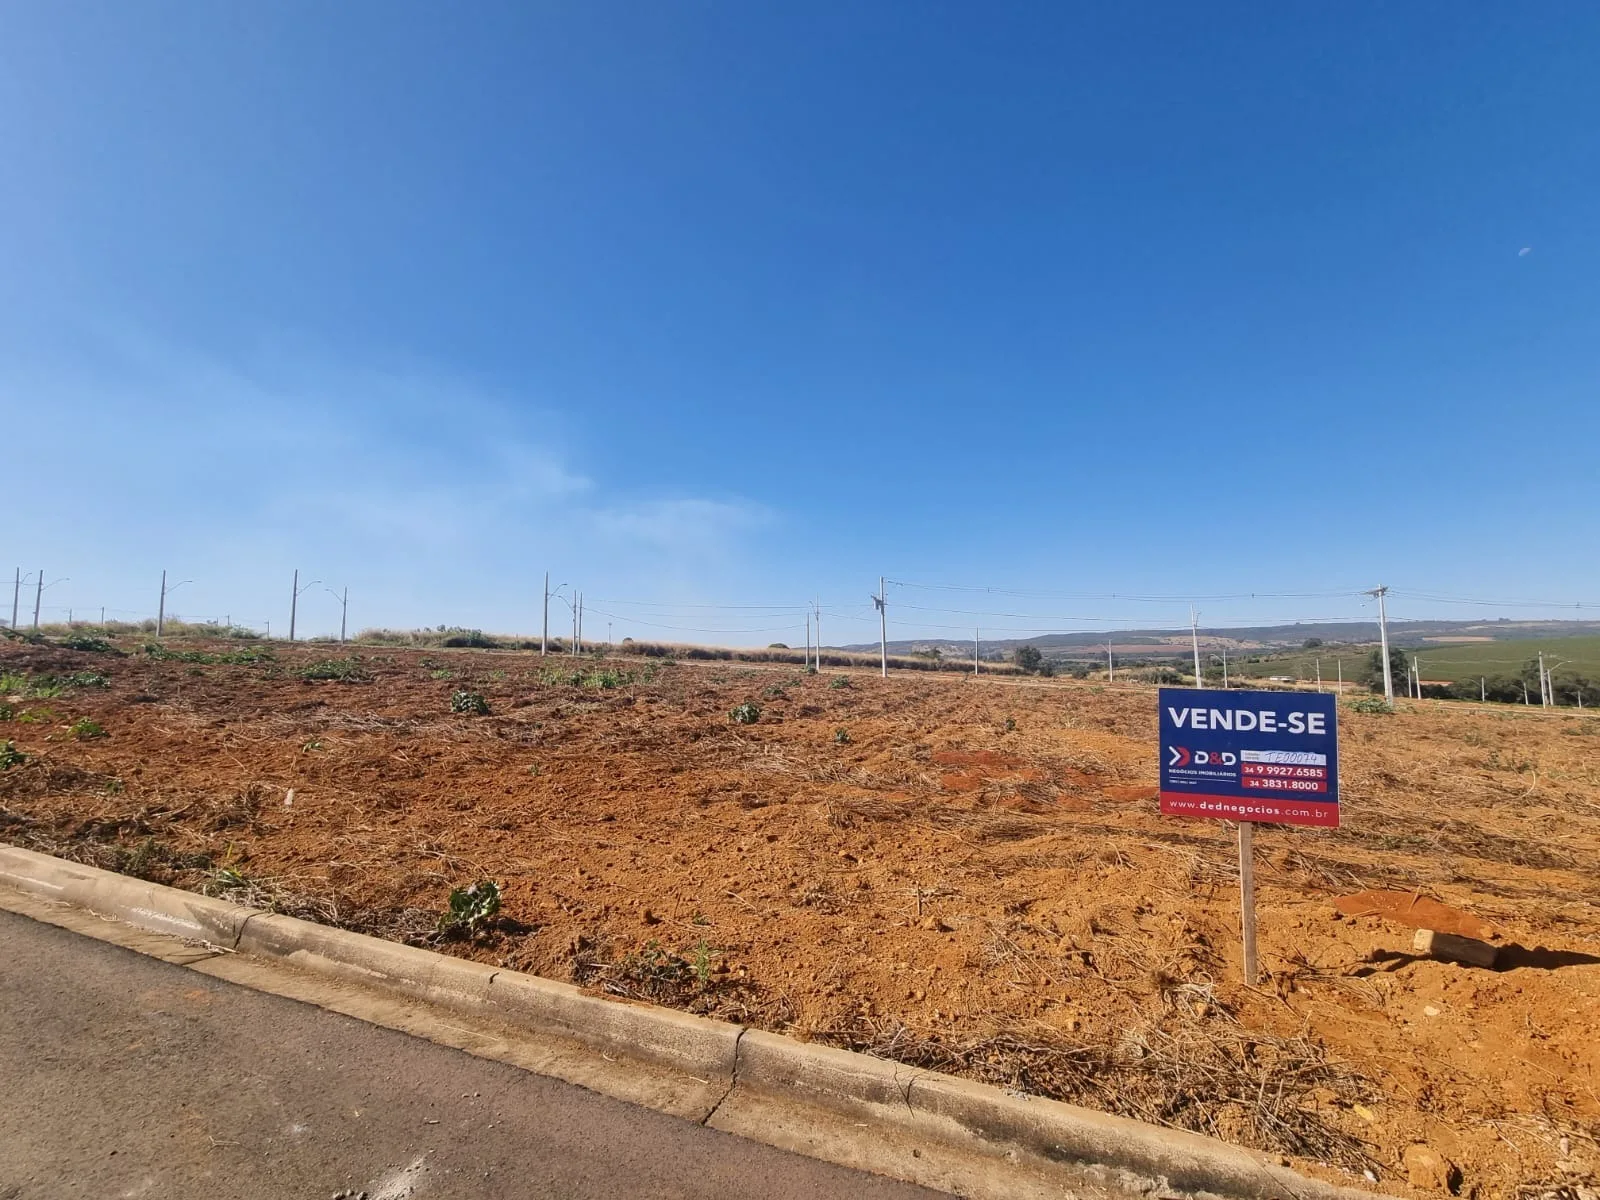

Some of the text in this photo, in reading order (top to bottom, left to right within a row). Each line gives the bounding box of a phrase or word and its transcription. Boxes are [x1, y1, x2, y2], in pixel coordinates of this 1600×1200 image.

[1168, 707, 1326, 735] VENDE-SE
[1194, 750, 1237, 766] D&D
[1257, 766, 1264, 774] 9
[1267, 766, 1323, 777] 9927.6585
[1262, 779, 1319, 790] 3831.8000
[1169, 800, 1328, 818] www.dednegocios.com.br
